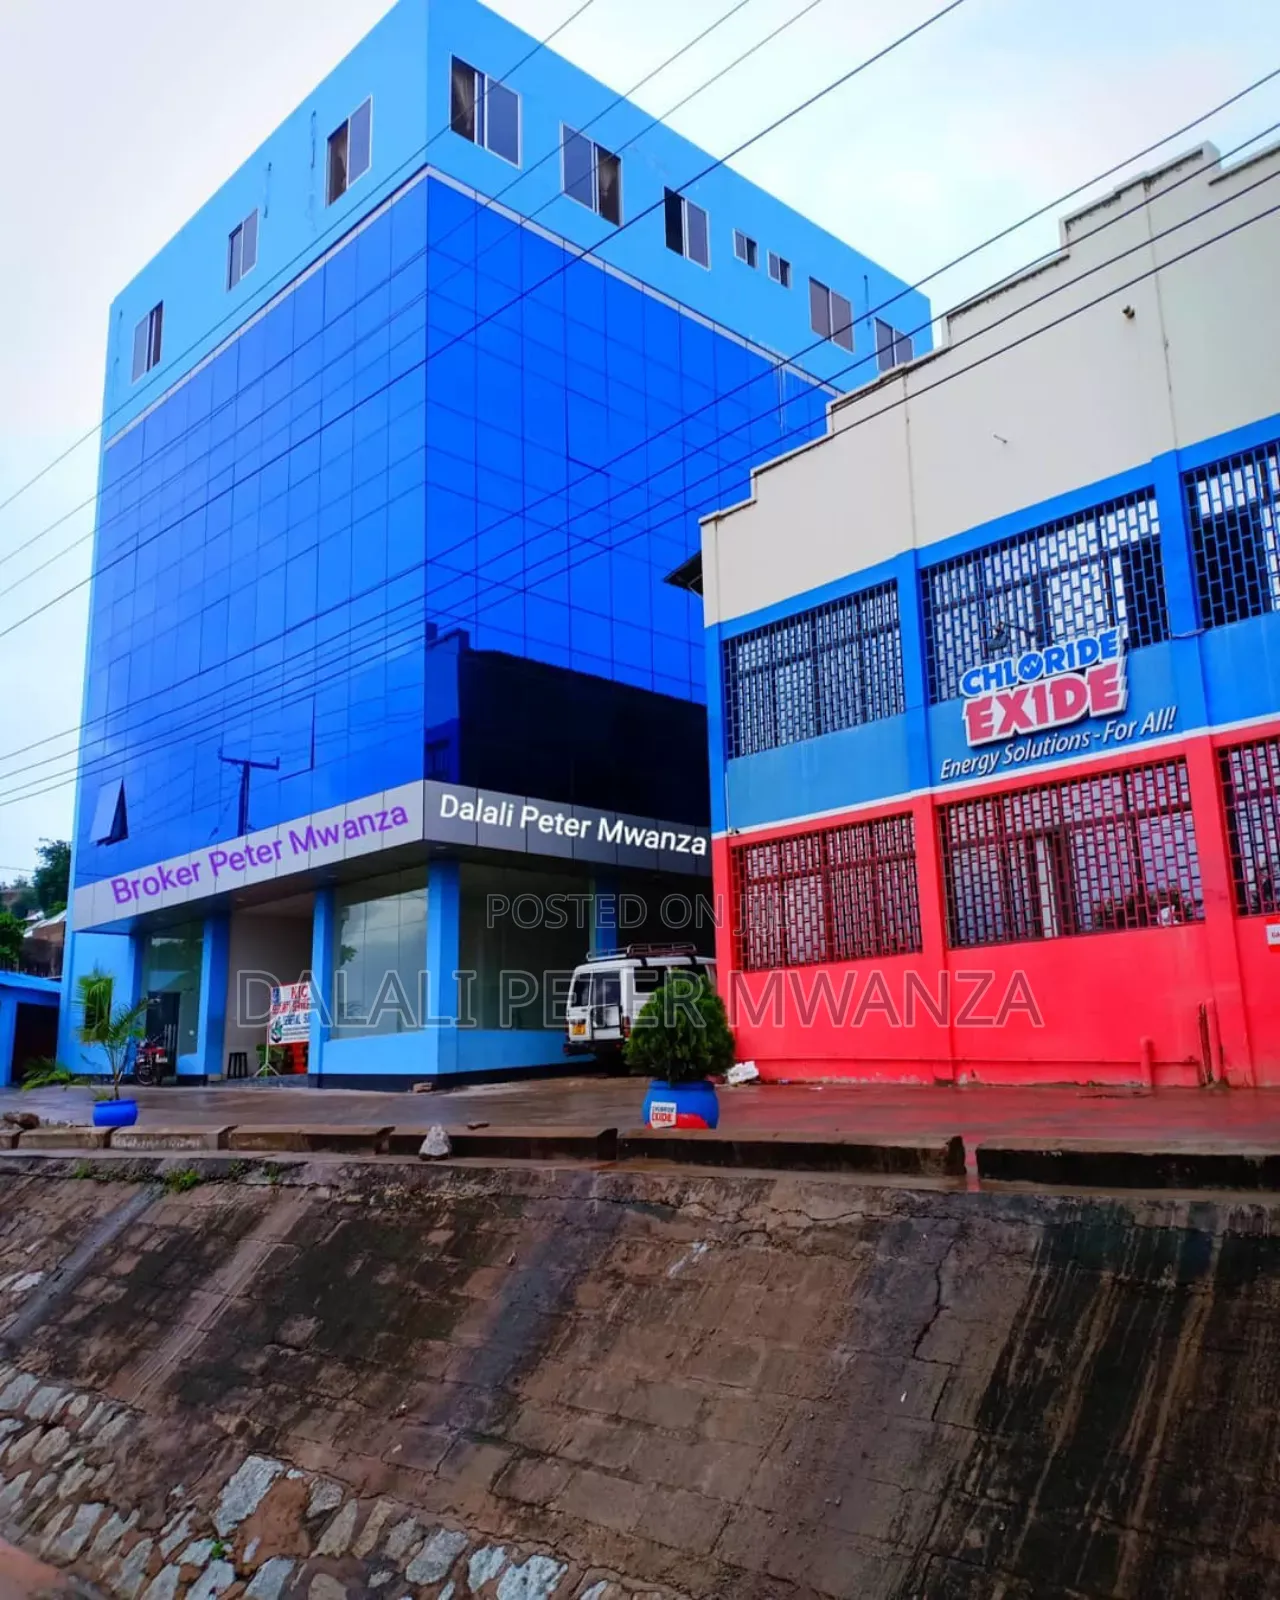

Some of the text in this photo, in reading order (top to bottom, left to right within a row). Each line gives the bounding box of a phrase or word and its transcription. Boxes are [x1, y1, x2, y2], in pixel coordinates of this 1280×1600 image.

[961, 629, 1120, 696] CHLORIDE
[965, 662, 1120, 742] EXIDE
[940, 750, 1000, 781] Energy
[1002, 729, 1090, 765] Solutions
[1103, 719, 1137, 744] For
[1140, 705, 1177, 735] All!
[110, 805, 409, 905] Broker Peter Mwanza
[439, 793, 708, 856] Dalali Peter Mwanza
